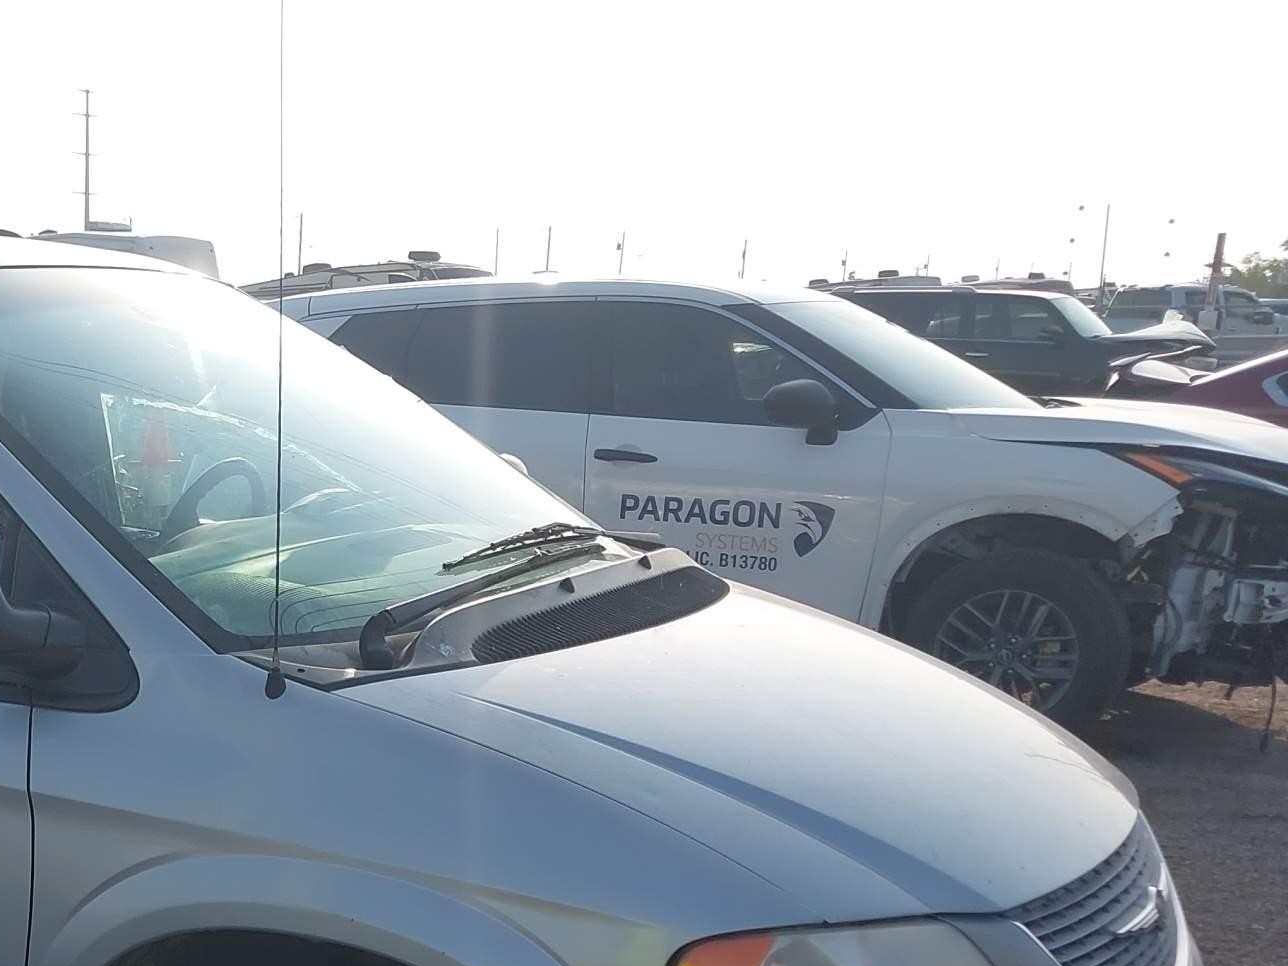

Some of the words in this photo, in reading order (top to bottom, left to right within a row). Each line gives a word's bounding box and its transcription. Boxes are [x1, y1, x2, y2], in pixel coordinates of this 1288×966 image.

[620, 494, 782, 528] PARAGON
[695, 533, 778, 553] SYSTEMS
[686, 551, 713, 566] IC.
[719, 553, 777, 571] B13780
